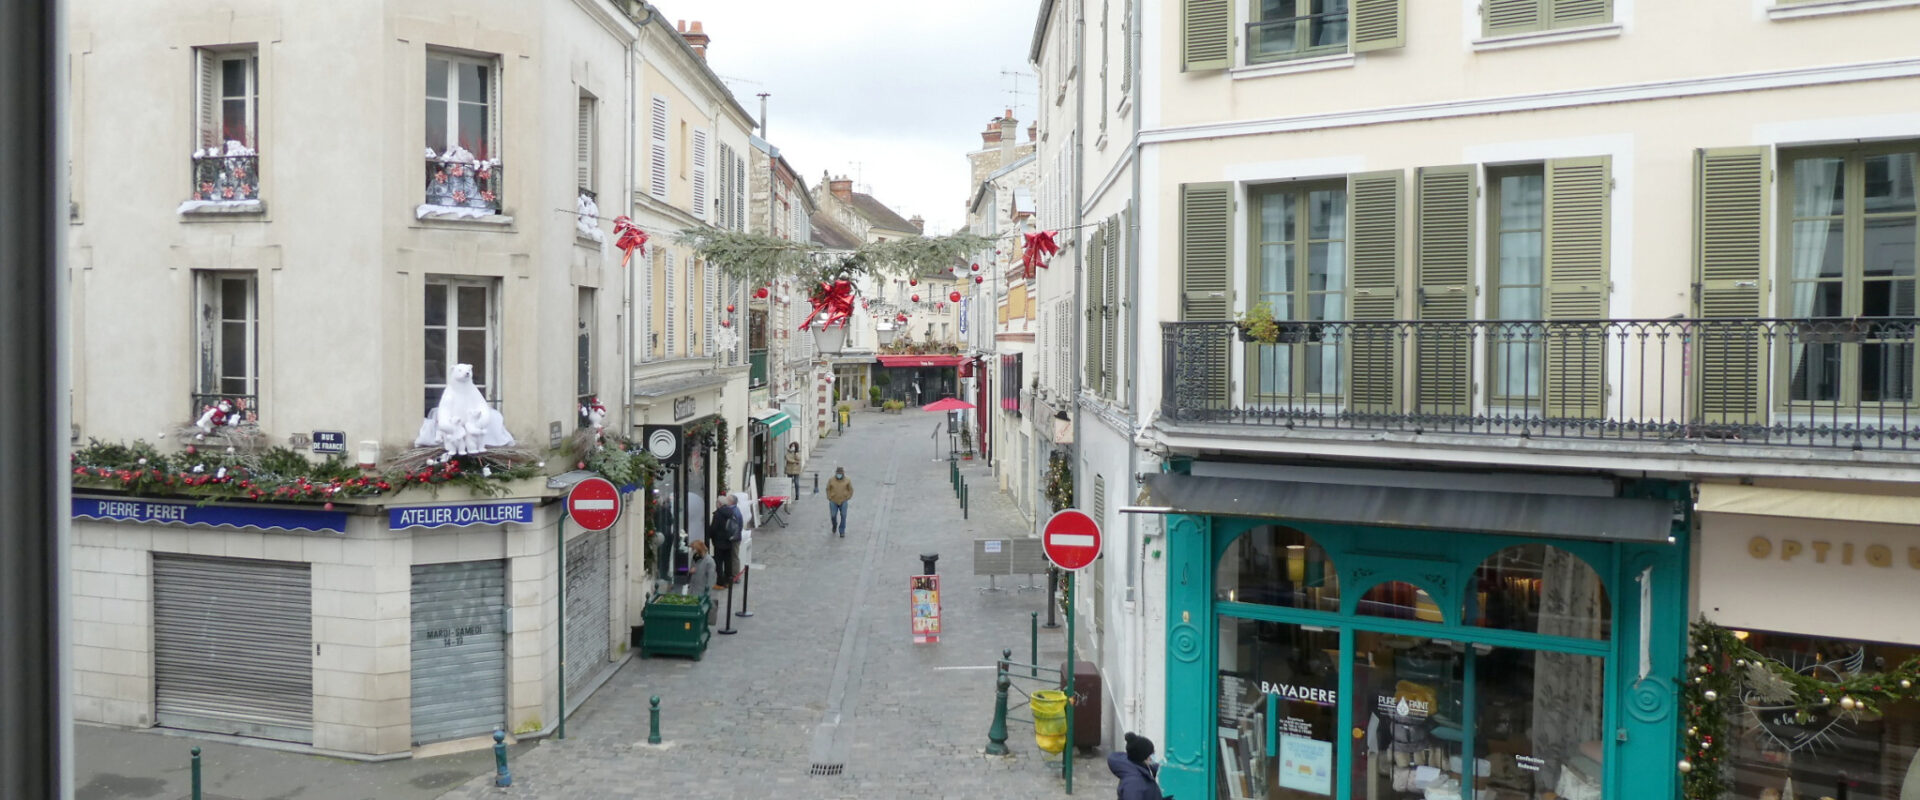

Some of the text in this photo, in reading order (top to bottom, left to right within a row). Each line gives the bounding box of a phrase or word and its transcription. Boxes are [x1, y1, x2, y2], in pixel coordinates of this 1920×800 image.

[321, 433, 335, 441] RUE
[321, 442, 343, 450] FRANCE
[98, 501, 187, 520] PIERRE FERET
[400, 505, 524, 525] ATELIER JOAILLERIE
[1261, 681, 1336, 704] BAYADERE
[1378, 695, 1429, 710] PURE PAINT
